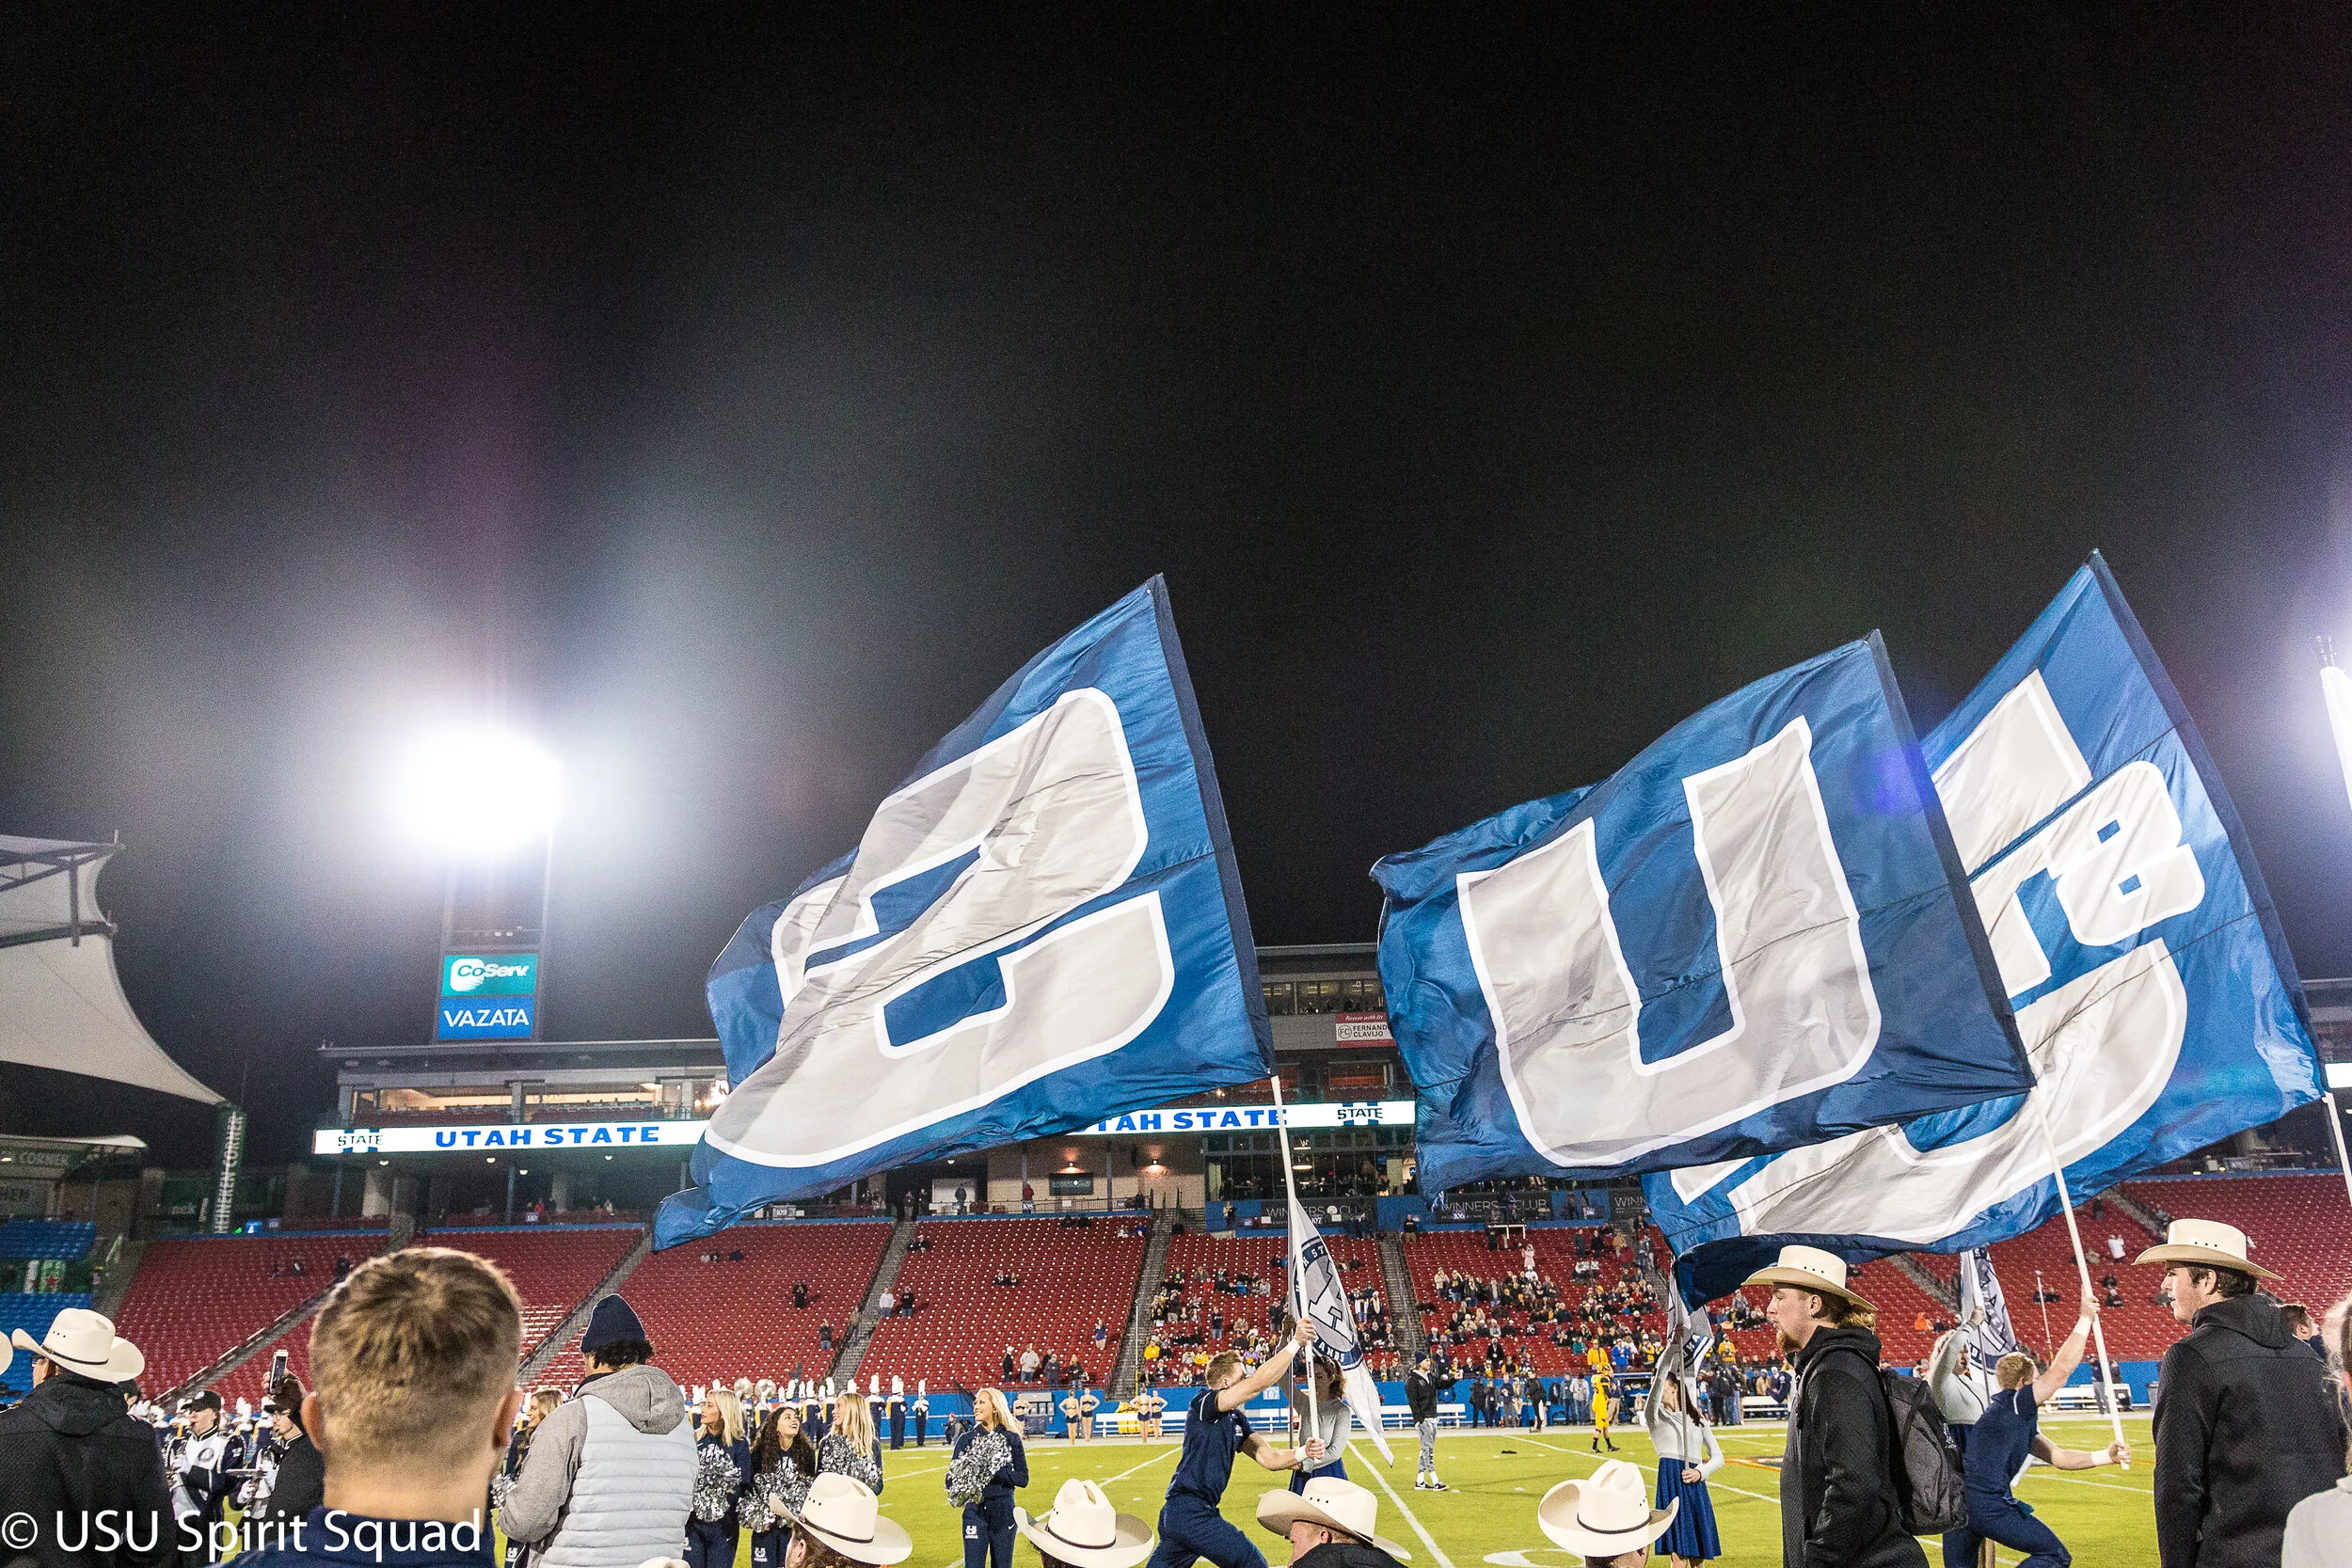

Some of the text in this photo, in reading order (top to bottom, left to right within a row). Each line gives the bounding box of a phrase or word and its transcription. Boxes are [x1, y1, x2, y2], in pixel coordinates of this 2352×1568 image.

[1457, 715, 1882, 1167] U
[457, 963, 529, 977] CoServ
[443, 1008, 530, 1027] VAZATA
[1098, 1109, 1288, 1132] TAH STATE
[1337, 1108, 1384, 1120] STATE
[338, 1135, 383, 1147] STATE
[436, 1126, 660, 1148] UTAH STATE
[1613, 1196, 1647, 1207] WINN
[1266, 1205, 1325, 1217] WINERS
